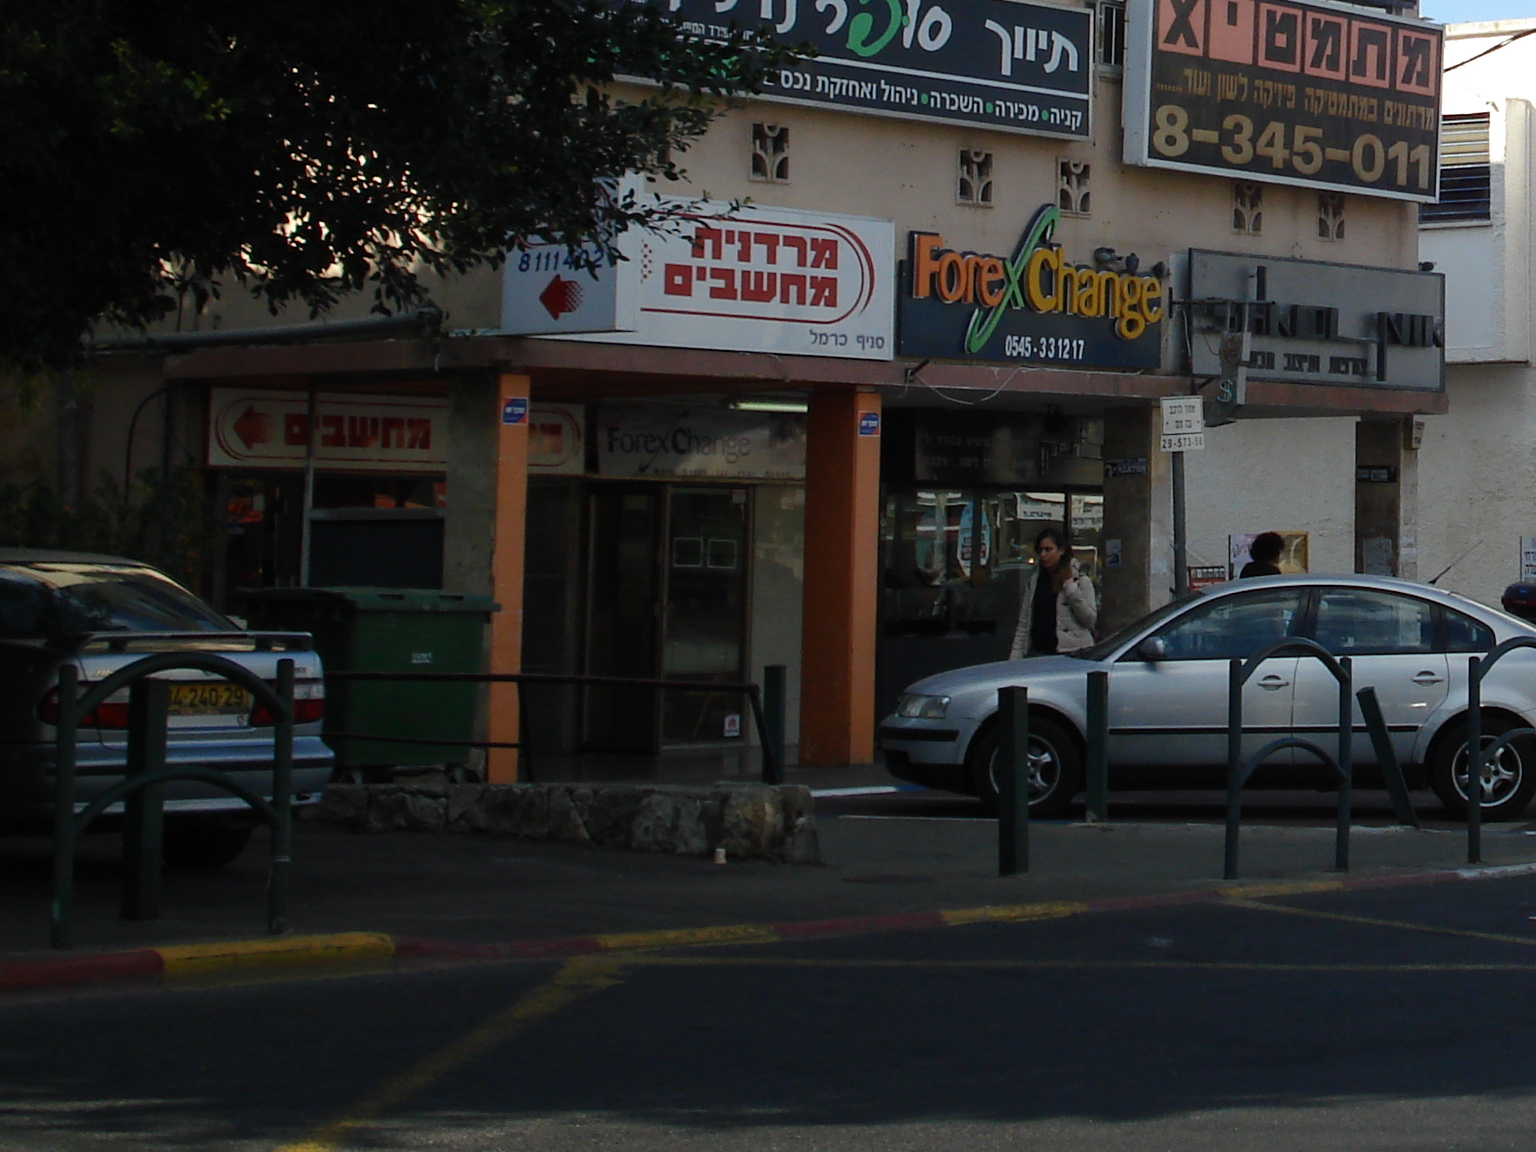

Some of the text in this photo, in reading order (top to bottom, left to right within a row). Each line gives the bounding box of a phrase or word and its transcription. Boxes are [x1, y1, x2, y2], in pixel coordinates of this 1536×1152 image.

[985, 19, 1078, 76] תיווך
[816, 75, 877, 100] ואחזקת
[881, 80, 918, 105] ניהול
[1217, 72, 1248, 102] לשון
[1254, 79, 1295, 109] פיזיקה
[930, 91, 983, 114] השכרה
[996, 100, 1039, 122] מכירה
[1304, 87, 1378, 121] במתמטיקה
[1050, 108, 1082, 131] קניה
[1153, 105, 1430, 189] 8-345-011
[664, 263, 837, 307] מחשבים
[810, 329, 885, 350] סניף כרמל
